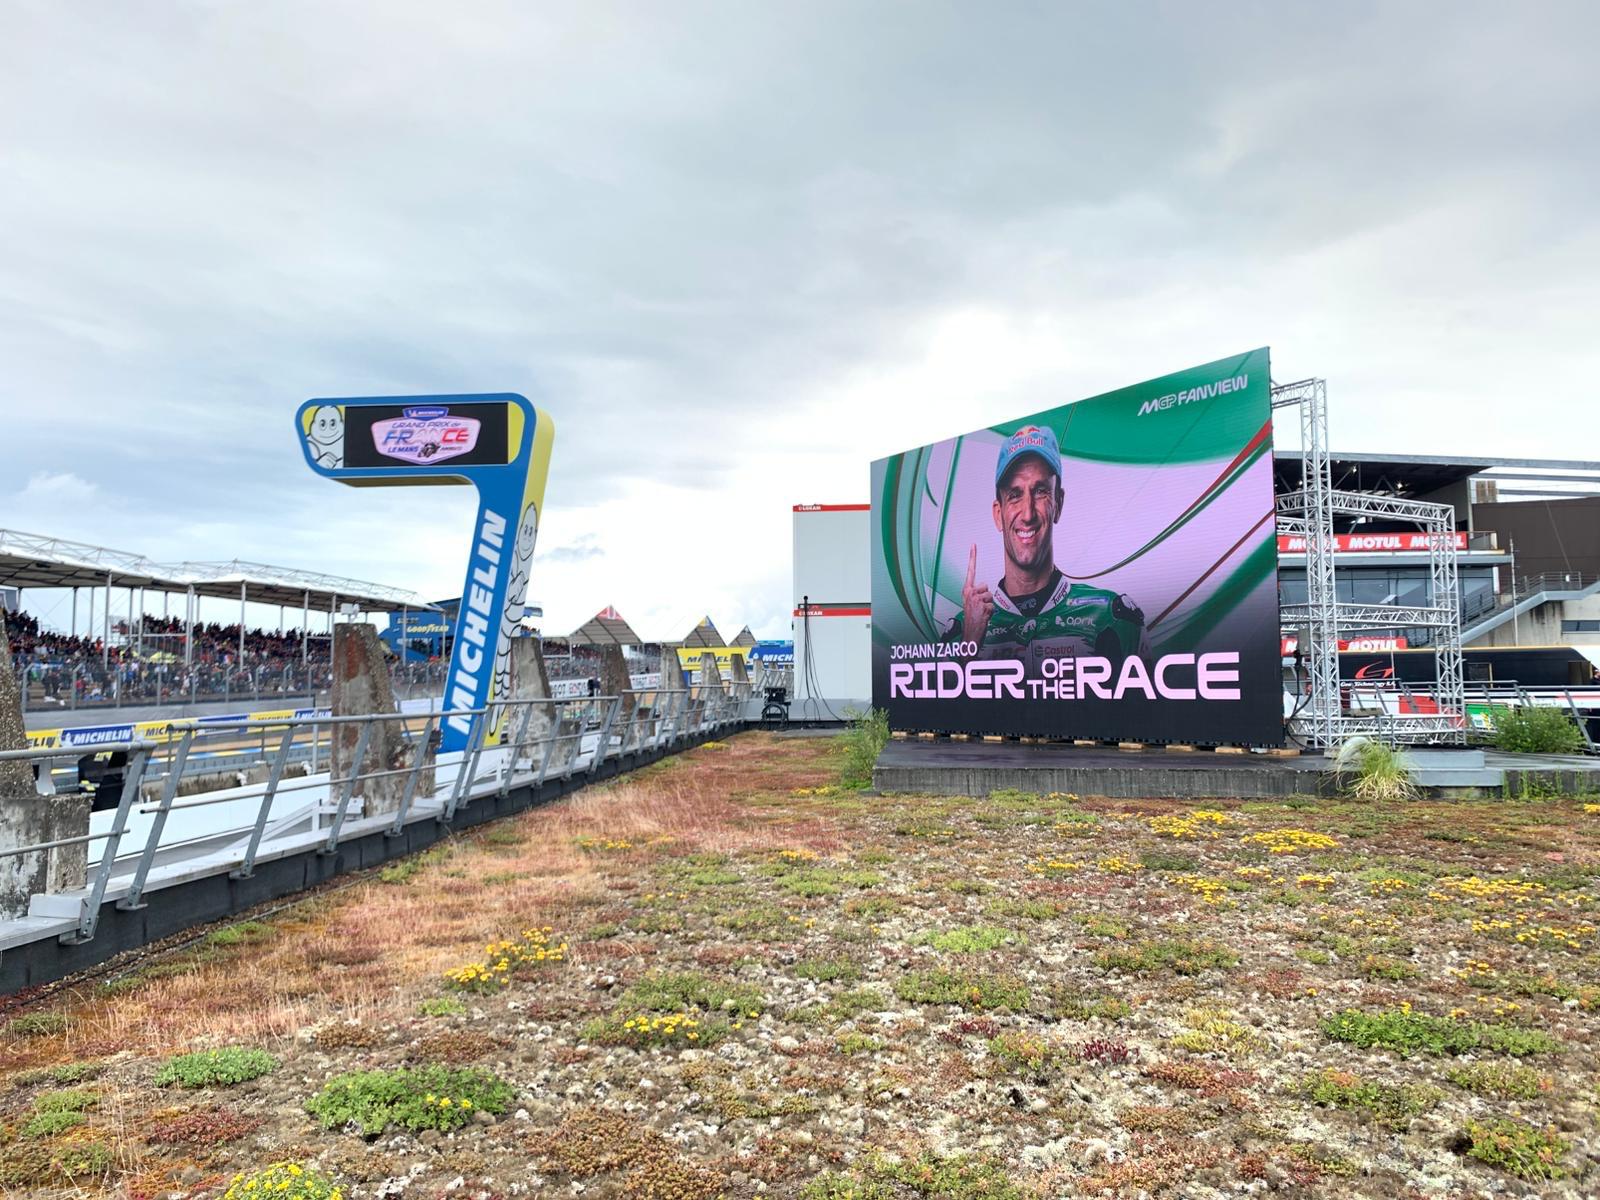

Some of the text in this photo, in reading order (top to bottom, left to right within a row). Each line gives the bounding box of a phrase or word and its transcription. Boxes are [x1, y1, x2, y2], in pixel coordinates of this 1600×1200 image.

[1178, 374, 1248, 406] FANVIEW
[1008, 437, 1043, 455] Red Bull
[1350, 536, 1402, 549] MOTUL
[407, 624, 449, 634] GOODYEAR
[448, 509, 506, 735] MICHELIN
[890, 645, 935, 660] JOHANN
[937, 641, 978, 658] ZARCO
[1044, 645, 1075, 656] Castrol
[1348, 639, 1398, 652] MOTUL
[763, 654, 794, 662] MICH
[890, 651, 1241, 700] RIDER OF THE RACE
[73, 729, 132, 745] MICHELIN
